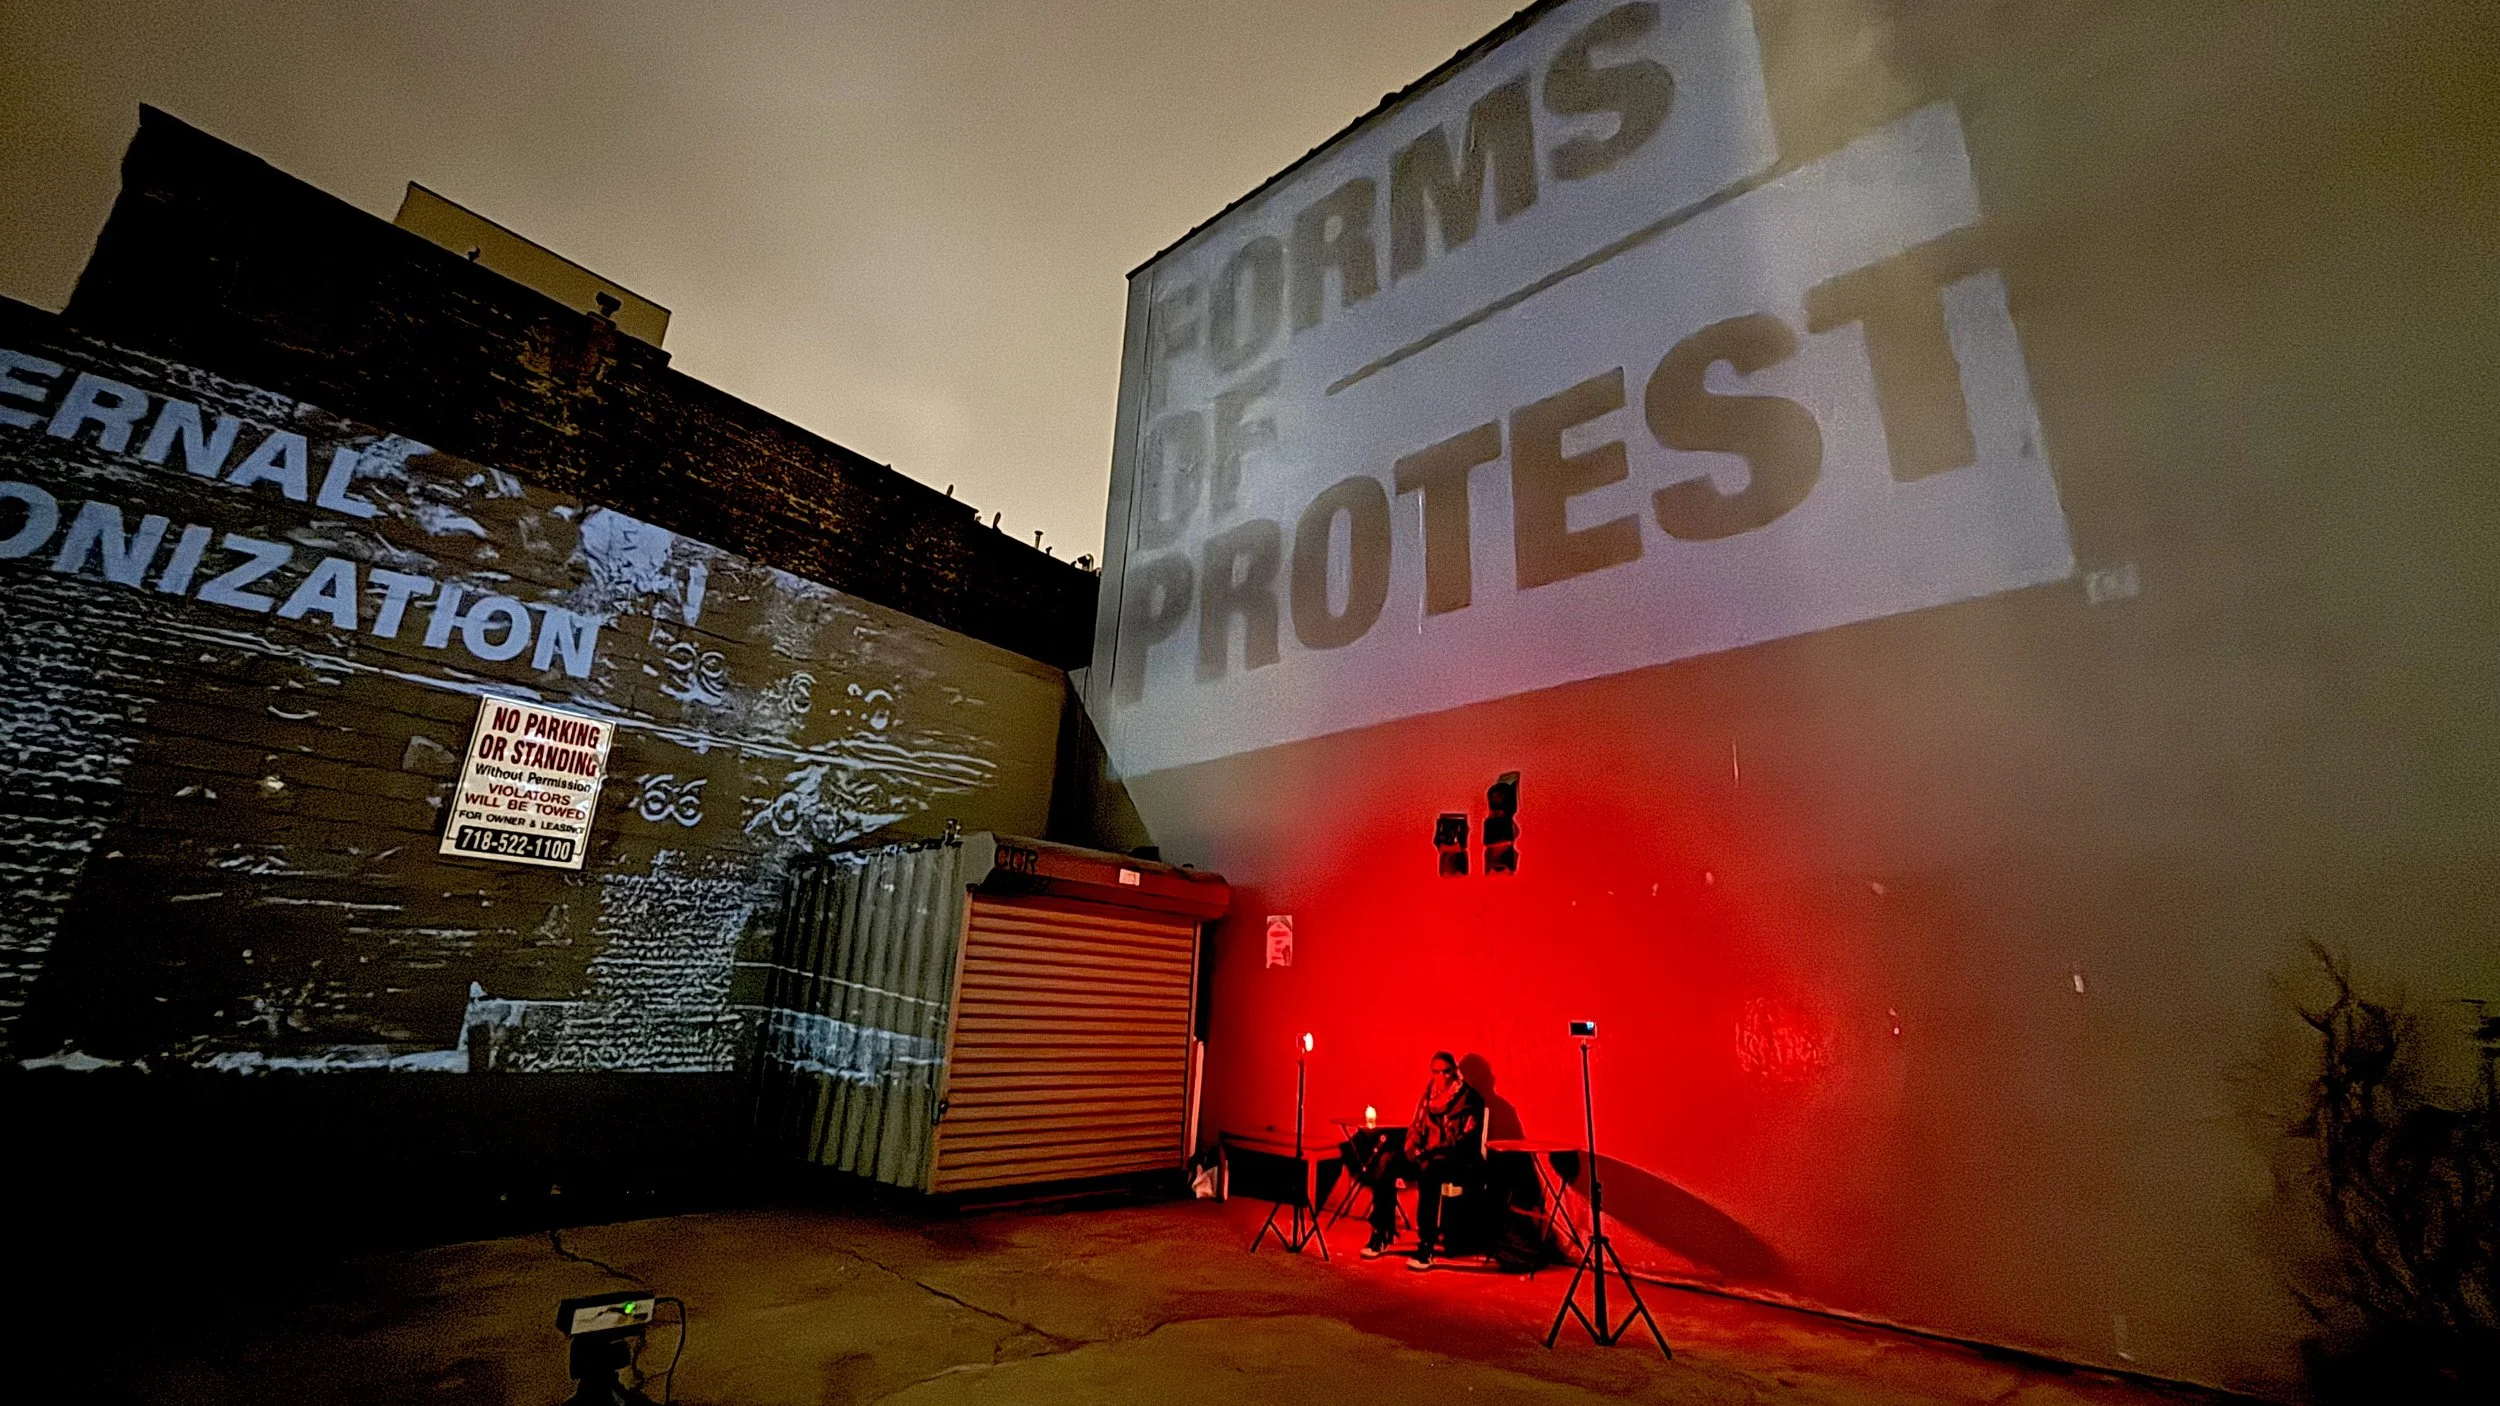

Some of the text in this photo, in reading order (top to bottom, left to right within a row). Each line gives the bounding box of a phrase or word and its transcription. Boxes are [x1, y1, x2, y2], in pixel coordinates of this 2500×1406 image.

[1152, 2, 1672, 410] FORMS
[0, 350, 384, 518] ERNAL
[1139, 359, 1286, 549] OF
[1113, 222, 1992, 706] PROTEST
[0, 481, 600, 680] ONIZATION
[492, 706, 600, 749] NO PARKING
[479, 734, 598, 777] OR STANDING
[475, 763, 592, 793] Without Permission
[489, 783, 571, 805] VIOLATORS
[459, 810, 482, 820] FOR
[486, 813, 526, 826] OWNER
[541, 821, 584, 834] LEASING
[465, 793, 586, 820] WILL BE TOWED
[461, 828, 571, 861] 718-522-1100
